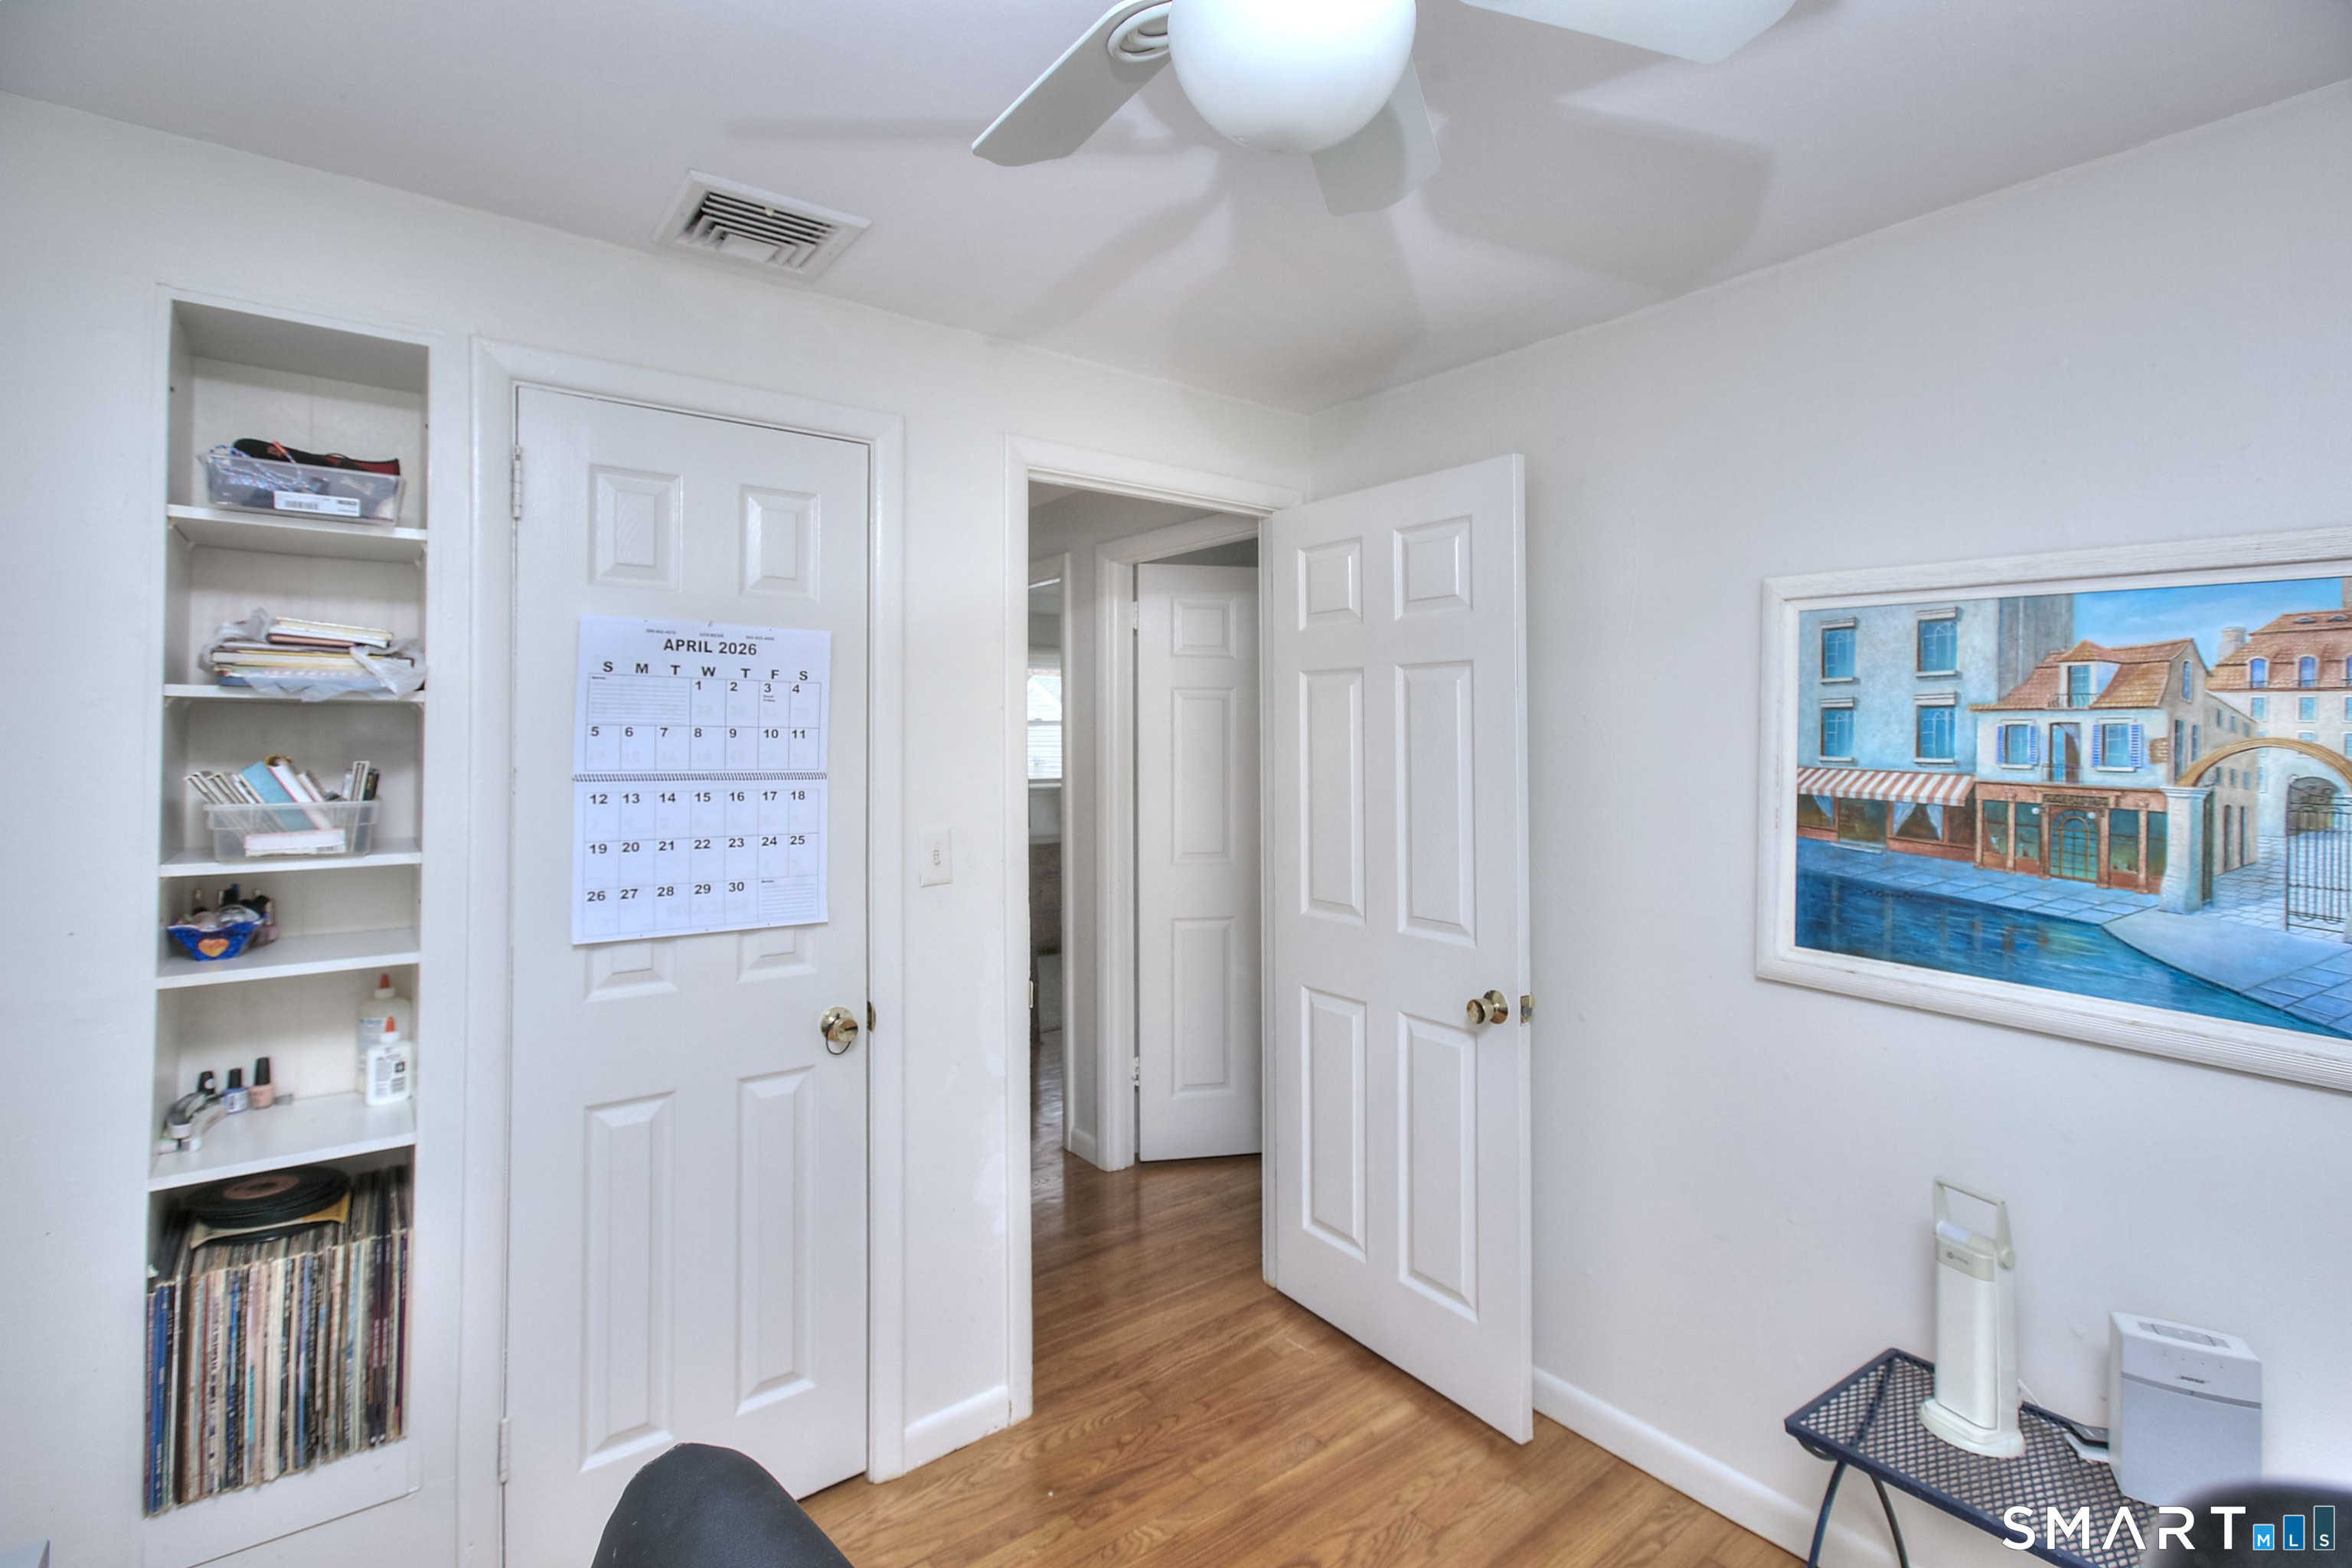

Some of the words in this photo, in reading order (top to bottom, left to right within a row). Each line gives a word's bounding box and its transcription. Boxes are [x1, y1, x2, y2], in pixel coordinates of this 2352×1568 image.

[663, 639, 713, 653] APRIL
[718, 642, 757, 655] 2026
[603, 661, 613, 673] S
[635, 663, 648, 674] M
[670, 665, 681, 675] T
[701, 666, 716, 677] W
[740, 668, 751, 678] T
[771, 669, 779, 680] F
[799, 671, 808, 681] S
[695, 681, 701, 691] 1
[730, 681, 738, 692] 2
[764, 683, 772, 693] 3
[792, 684, 800, 694] 4
[590, 726, 599, 737] 5
[625, 727, 634, 737] 6
[660, 727, 668, 737] 7
[694, 727, 702, 738] 8
[729, 728, 737, 738] 9
[763, 729, 779, 739] 10
[792, 729, 805, 739] 11
[590, 793, 608, 805] 12
[623, 793, 640, 804] 13
[660, 792, 676, 803] 14
[694, 792, 711, 802] 15
[729, 792, 745, 802] 16
[763, 791, 778, 801] 17
[791, 790, 805, 800] 18
[590, 843, 607, 854] 19
[622, 841, 640, 853] 20
[658, 841, 674, 851] 21
[694, 839, 710, 850] 22
[728, 838, 745, 848] 23
[762, 836, 777, 847] 24
[790, 835, 805, 845] 25
[587, 890, 606, 902] 26
[621, 888, 639, 900] 27
[657, 886, 675, 897] 28
[694, 884, 711, 894] 29
[728, 881, 745, 893] 30
